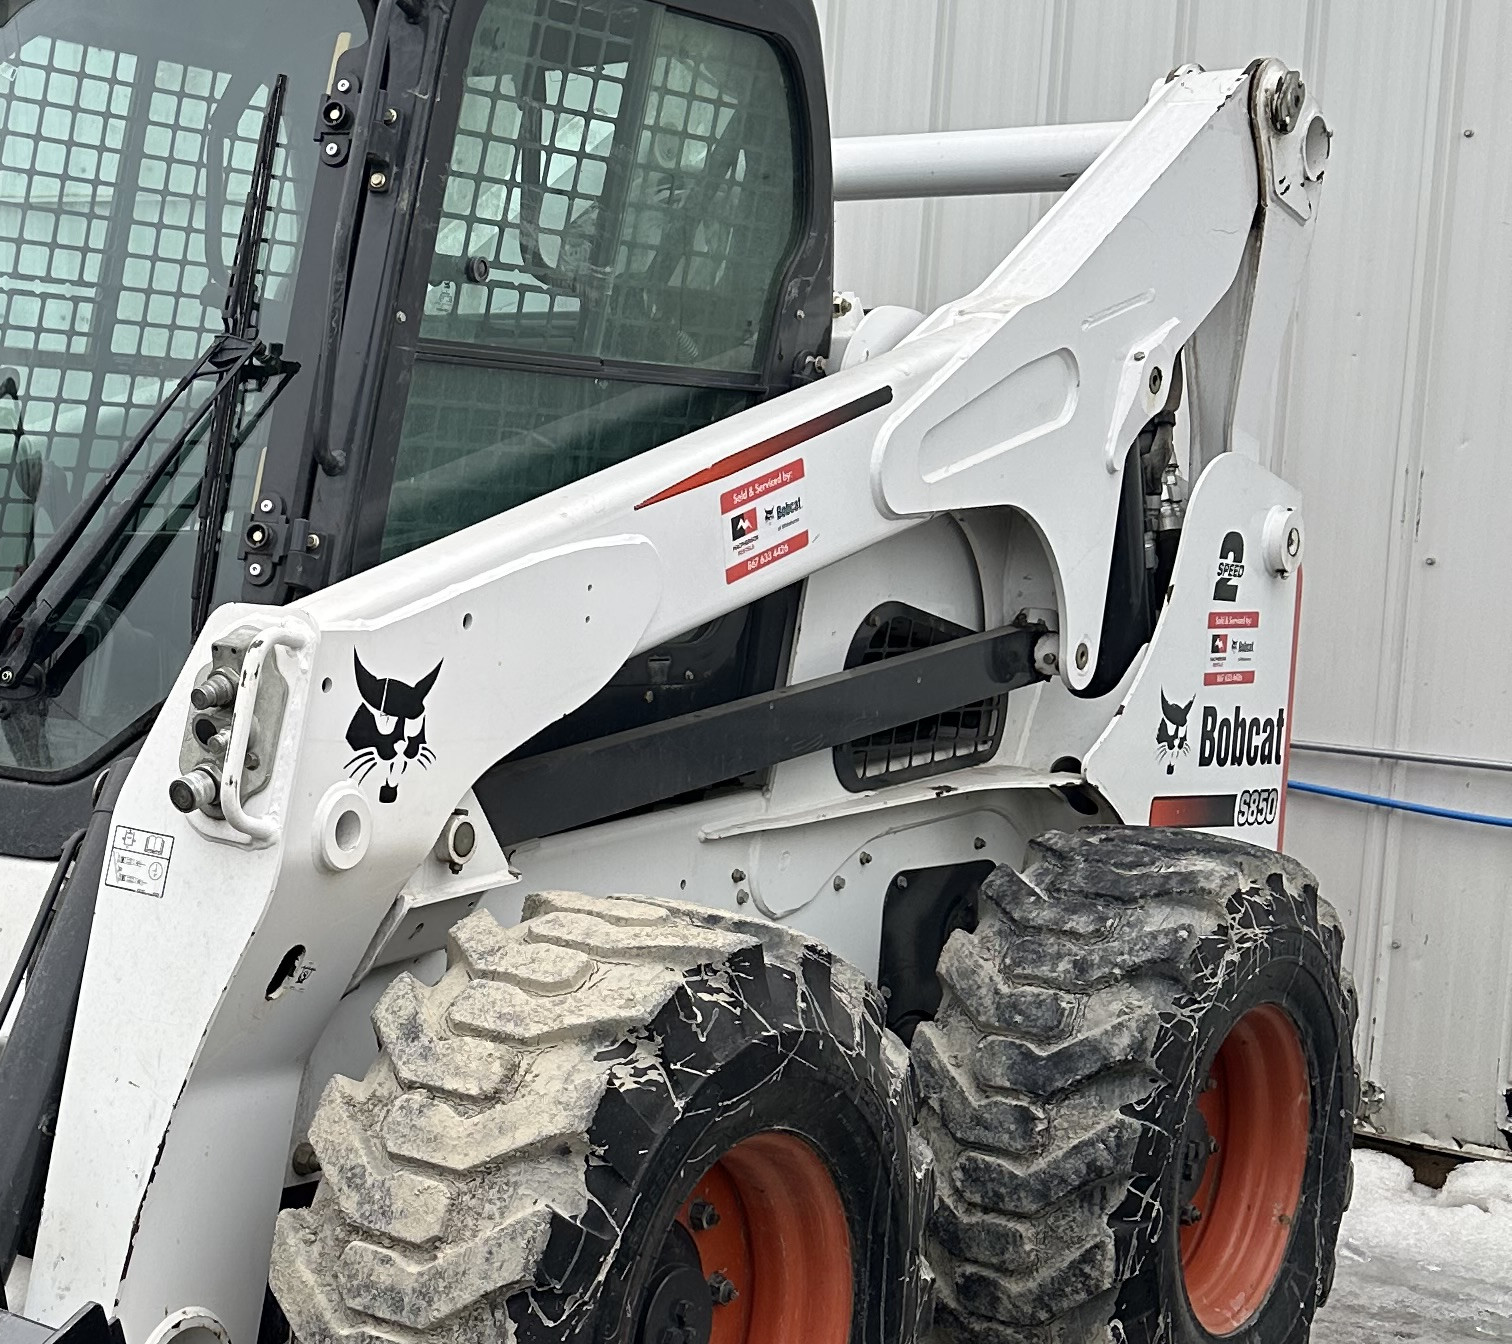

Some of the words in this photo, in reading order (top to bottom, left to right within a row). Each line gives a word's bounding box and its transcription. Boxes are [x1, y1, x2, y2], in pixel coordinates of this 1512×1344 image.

[732, 487, 748, 504] Sold
[748, 486, 755, 497] &
[755, 472, 782, 494] Serviced
[776, 497, 802, 520] Bobcat
[747, 557, 759, 571] 867
[759, 552, 773, 565] 633
[1213, 531, 1244, 602] 2
[1217, 562, 1245, 578] SPEED
[1198, 706, 1285, 767] Bobcat
[1237, 788, 1279, 827] S850
